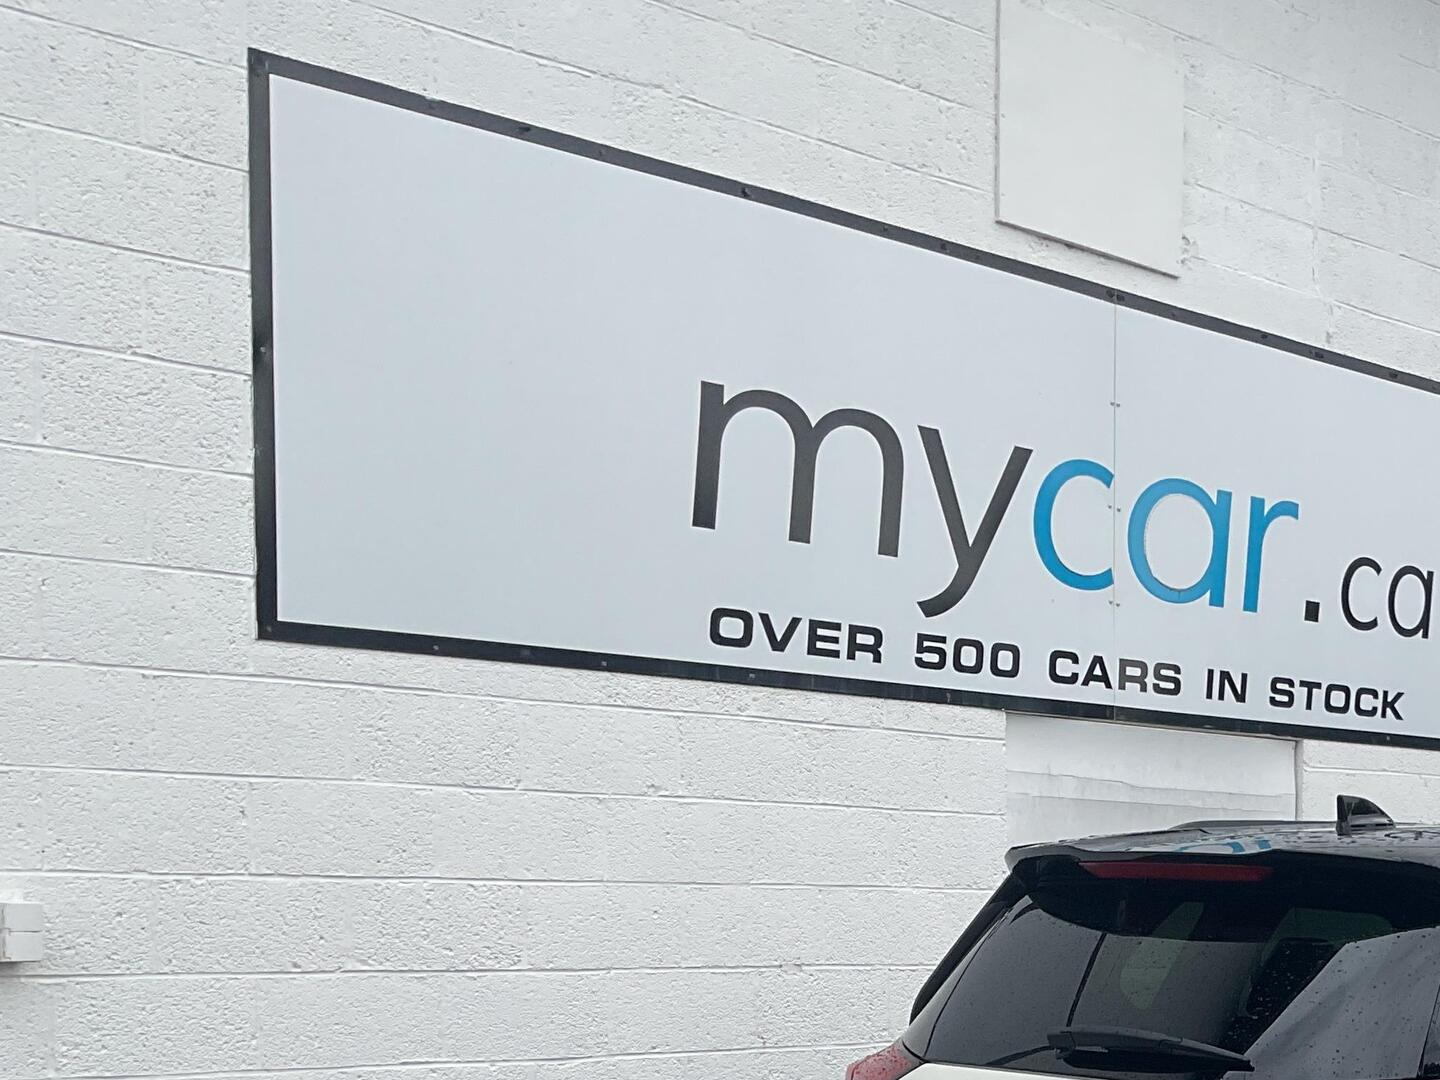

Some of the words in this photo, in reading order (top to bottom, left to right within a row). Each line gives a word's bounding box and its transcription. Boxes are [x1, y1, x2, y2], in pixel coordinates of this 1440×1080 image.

[690, 380, 1435, 640] mycar.ca
[708, 607, 884, 664] OVER
[914, 634, 1022, 679] 500
[1048, 650, 1182, 696] CARS
[1205, 668, 1249, 704] IN
[1268, 677, 1406, 721] STOCK
